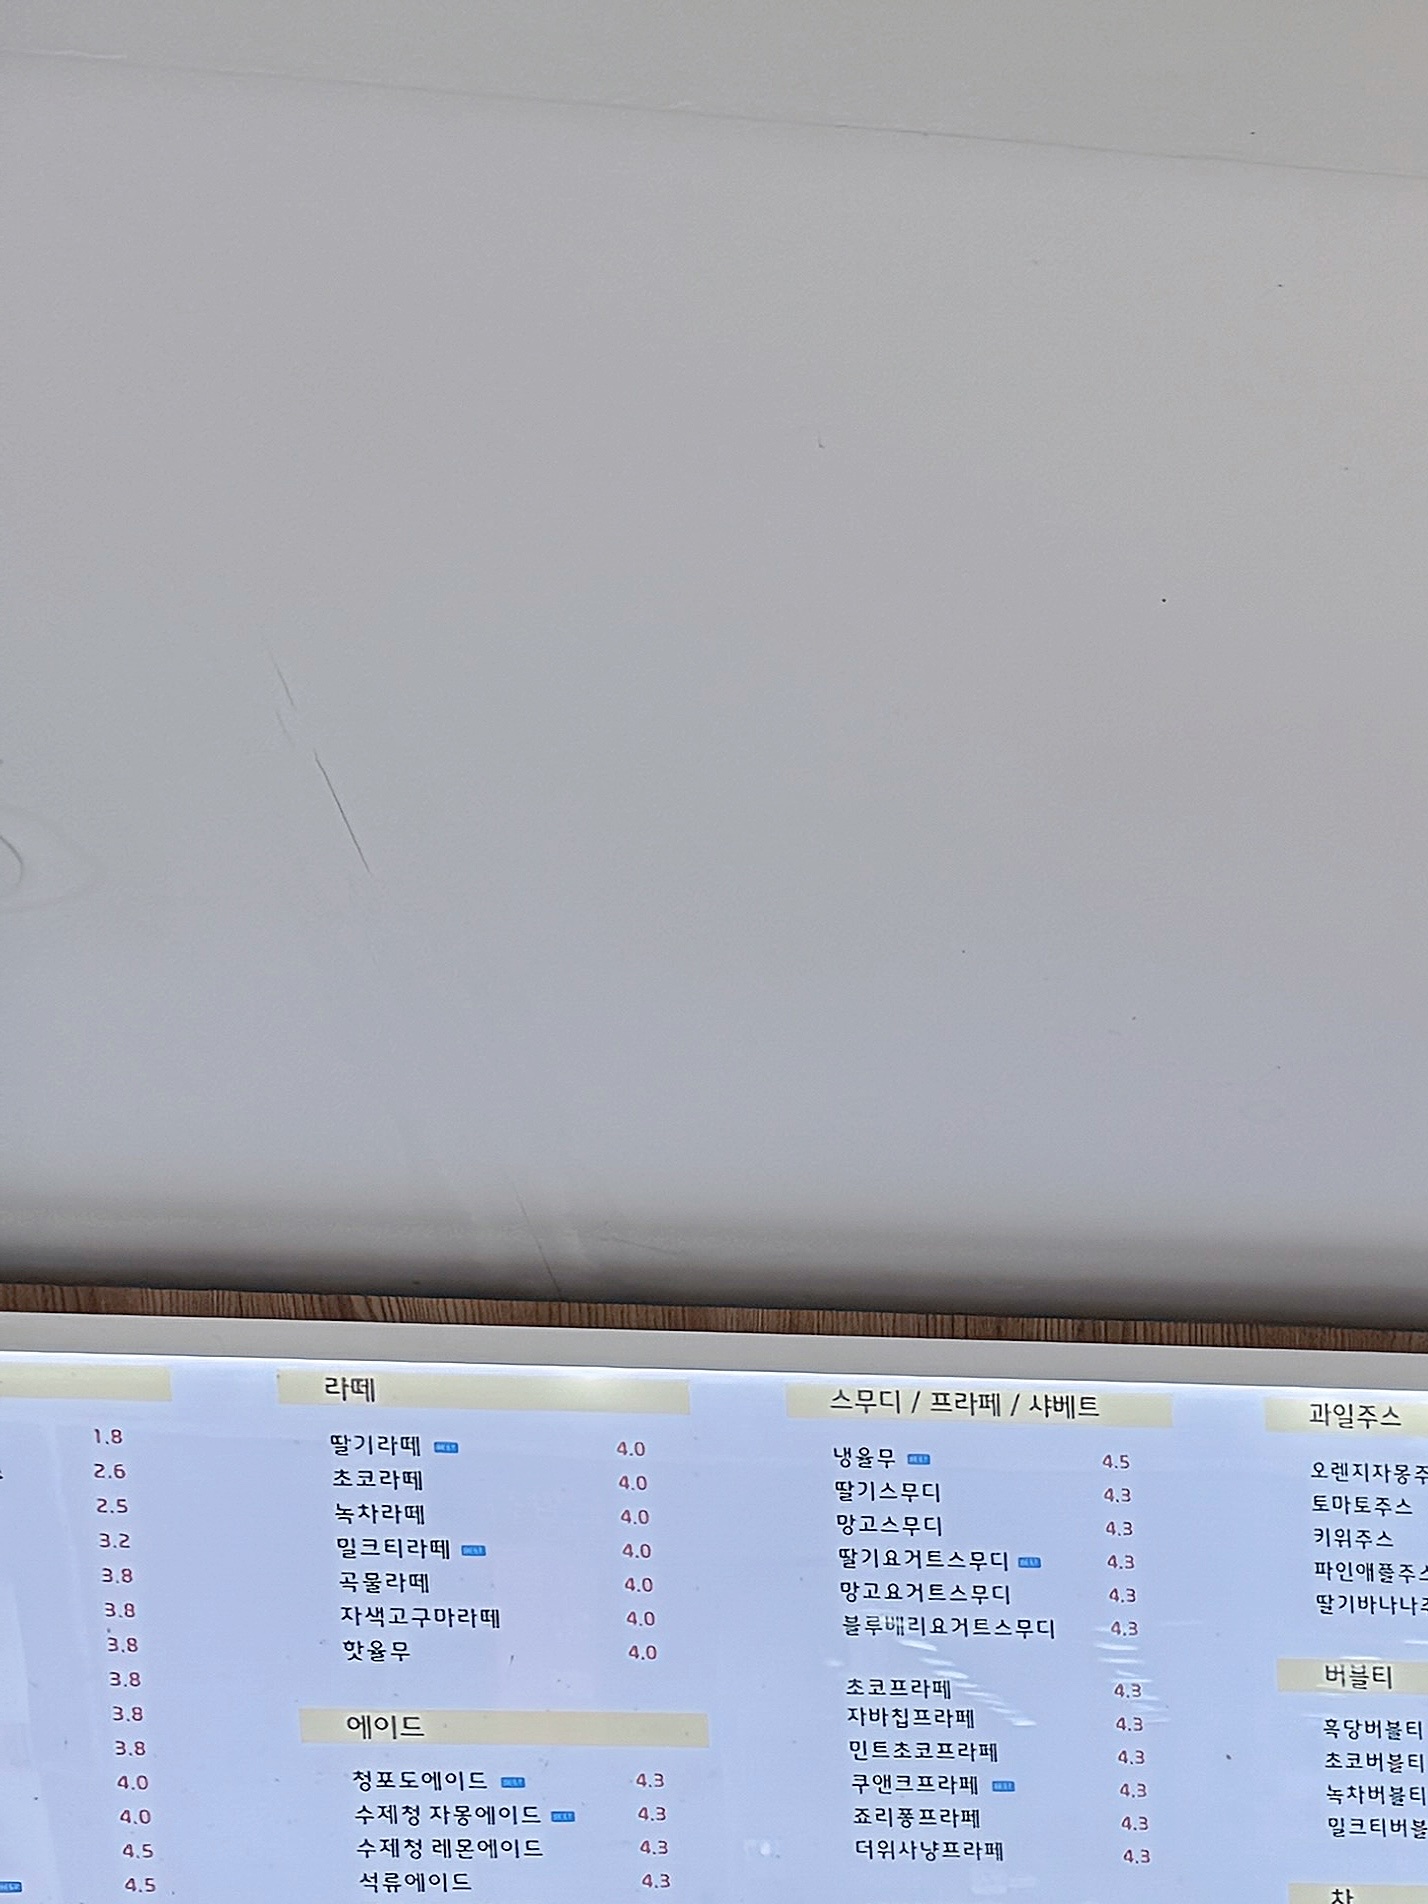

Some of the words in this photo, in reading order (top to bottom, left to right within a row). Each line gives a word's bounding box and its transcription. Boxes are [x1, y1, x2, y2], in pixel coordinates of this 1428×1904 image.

[325, 1377, 375, 1402] 라떼
[830, 1389, 900, 1414] 스무디
[930, 1392, 1000, 1417] 프라페
[1029, 1394, 1099, 1419] 샤베트
[1310, 1403, 1401, 1429] 과일주스
[95, 1429, 122, 1444] 1.8
[331, 1435, 420, 1456] 딸기라떼
[617, 1442, 645, 1456] 4.0
[834, 1447, 895, 1469] 냉율무
[1103, 1455, 1129, 1469] 4.5
[94, 1464, 126, 1479] 2.6
[333, 1469, 422, 1490] 초코라떼
[619, 1476, 647, 1490] 4.0
[835, 1481, 940, 1503] 딸기스무디
[1104, 1488, 1131, 1502] 4.3
[97, 1498, 128, 1513] 2.5
[335, 1503, 424, 1525] 녹차라떼
[621, 1510, 649, 1524] 4.0
[1312, 1495, 1413, 1517] 토마토주스
[837, 1514, 941, 1536] 망고스무디
[1106, 1522, 1132, 1536] 4.3
[100, 1533, 130, 1548] 3.2
[337, 1538, 449, 1559] 밀크티라떼
[623, 1544, 651, 1558] 4.0
[1314, 1528, 1393, 1549] 키위주스
[839, 1548, 1008, 1571] 딸기요거트스무디
[1108, 1555, 1134, 1569] 4.3
[102, 1568, 133, 1583] 3.8
[339, 1572, 429, 1593] 곡물라떼
[625, 1578, 653, 1592] 4.0
[840, 1582, 1010, 1605] 망고요거트스무디
[1109, 1588, 1135, 1603] 4.3
[105, 1603, 135, 1618] 3.8
[341, 1607, 500, 1628] 자색고구마라떼
[627, 1612, 655, 1626] 4.0
[1111, 1621, 1138, 1636] 4.3
[108, 1637, 138, 1653] 3.8
[343, 1640, 410, 1662] 핫율무
[629, 1645, 656, 1660] 4.0
[110, 1672, 141, 1687] 3.8
[1326, 1665, 1392, 1690] 버블티
[846, 1679, 951, 1699] 초코프라페
[1114, 1684, 1141, 1698] 4.3
[113, 1706, 143, 1721] 3.8
[848, 1707, 974, 1729] 자바칩프라페
[1116, 1717, 1143, 1731] 4.3
[347, 1715, 424, 1739] 에이드
[1323, 1719, 1422, 1740] 흑당버블티
[116, 1741, 145, 1756] 3.8
[850, 1741, 997, 1762] 민트초코프라페
[1118, 1750, 1144, 1764] 4.3
[1325, 1752, 1424, 1773] 초코버블티
[117, 1775, 148, 1790] 4.0
[353, 1771, 487, 1792] 청포도에이드
[636, 1773, 664, 1787] 4.3
[852, 1774, 978, 1795] 쿠앤크프라페
[1120, 1783, 1146, 1798] 4.3
[1326, 1785, 1426, 1806] 녹차버블티
[120, 1810, 151, 1824] 4.0
[355, 1805, 420, 1826] 수제청
[430, 1805, 541, 1826] 자몽에이드
[638, 1807, 666, 1821] 4.3
[853, 1808, 980, 1828] 죠리퐁프라페
[1122, 1817, 1148, 1830] 4.3
[123, 1844, 153, 1858] 4.5
[357, 1838, 422, 1859] 수제청
[432, 1839, 543, 1859] 레몬에이드
[640, 1840, 668, 1855] 4.3
[856, 1840, 1003, 1861] 더위사냥프라페
[1124, 1849, 1150, 1864] 4.3
[125, 1878, 156, 1892] 4.5
[360, 1872, 472, 1893] 석류에이드
[642, 1874, 670, 1888] 4.3
